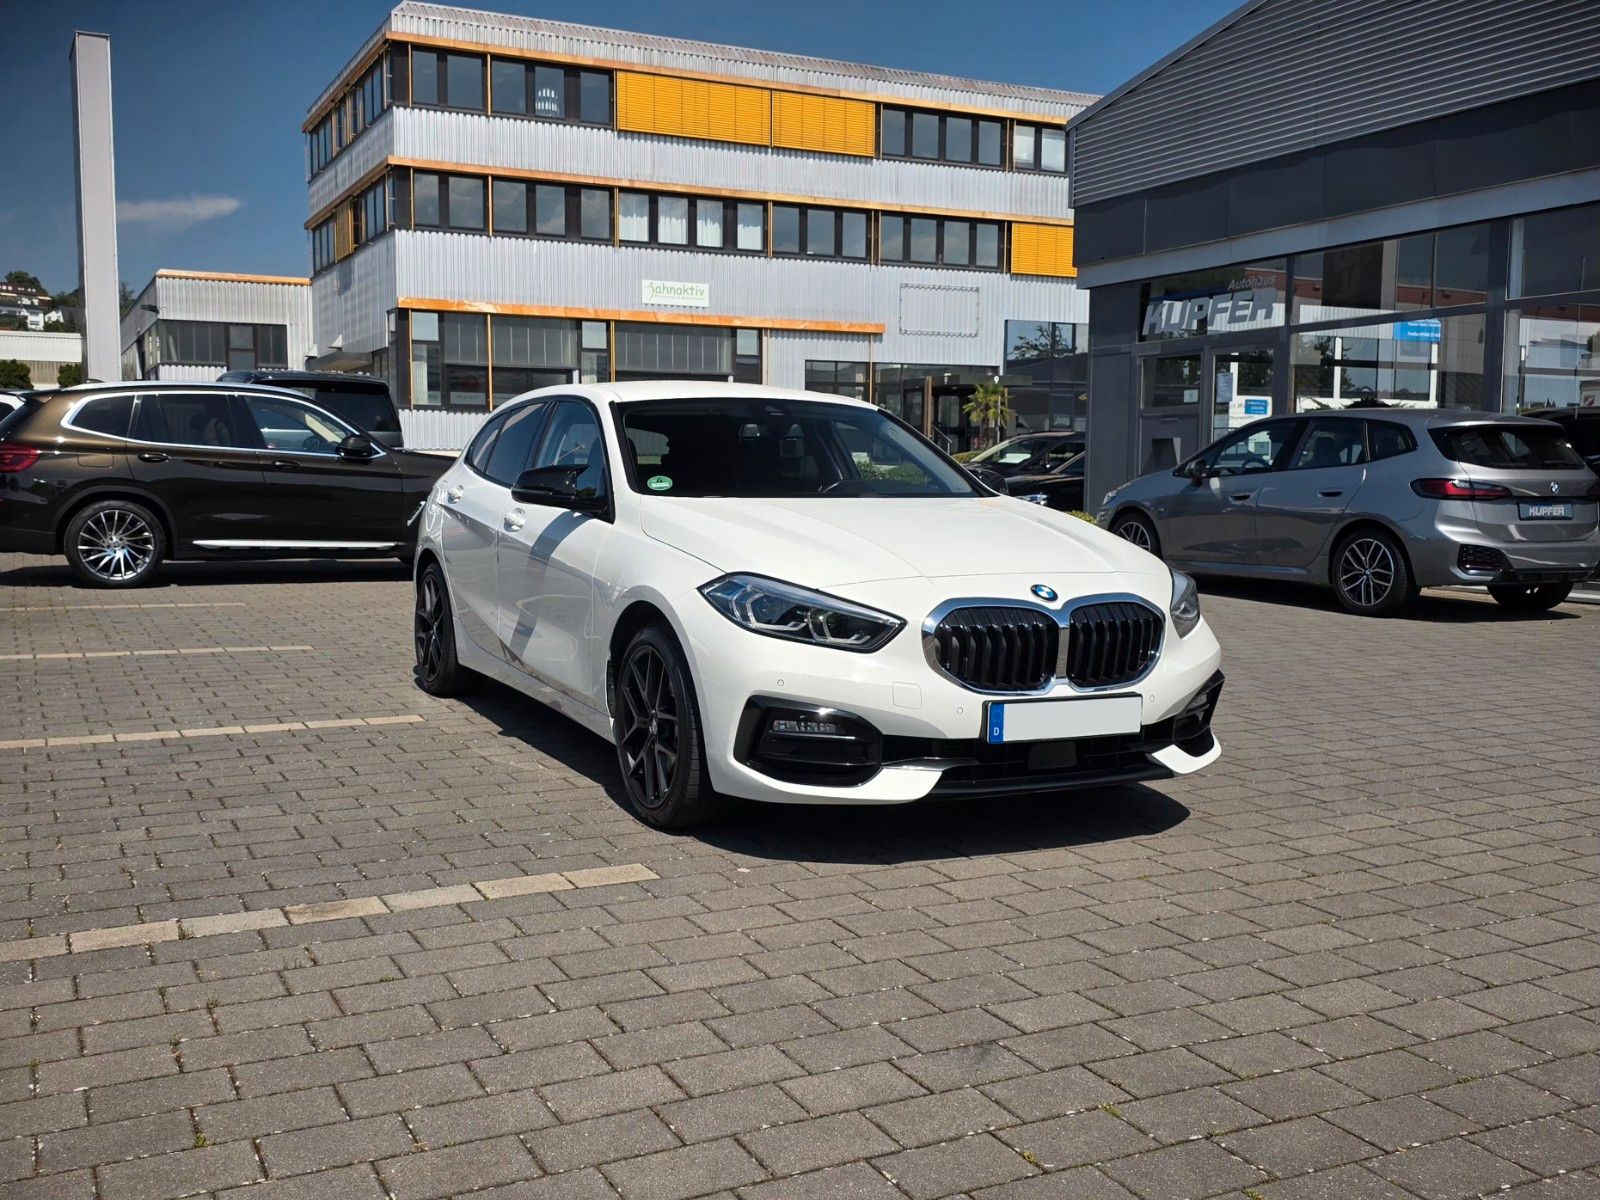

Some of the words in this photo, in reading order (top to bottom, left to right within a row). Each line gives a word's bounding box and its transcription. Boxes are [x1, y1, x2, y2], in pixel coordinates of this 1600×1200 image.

[1227, 275, 1276, 291] Autohaus
[1142, 287, 1277, 336] KUPFER
[1528, 505, 1565, 517] KUPFER
[993, 726, 1000, 736] D
